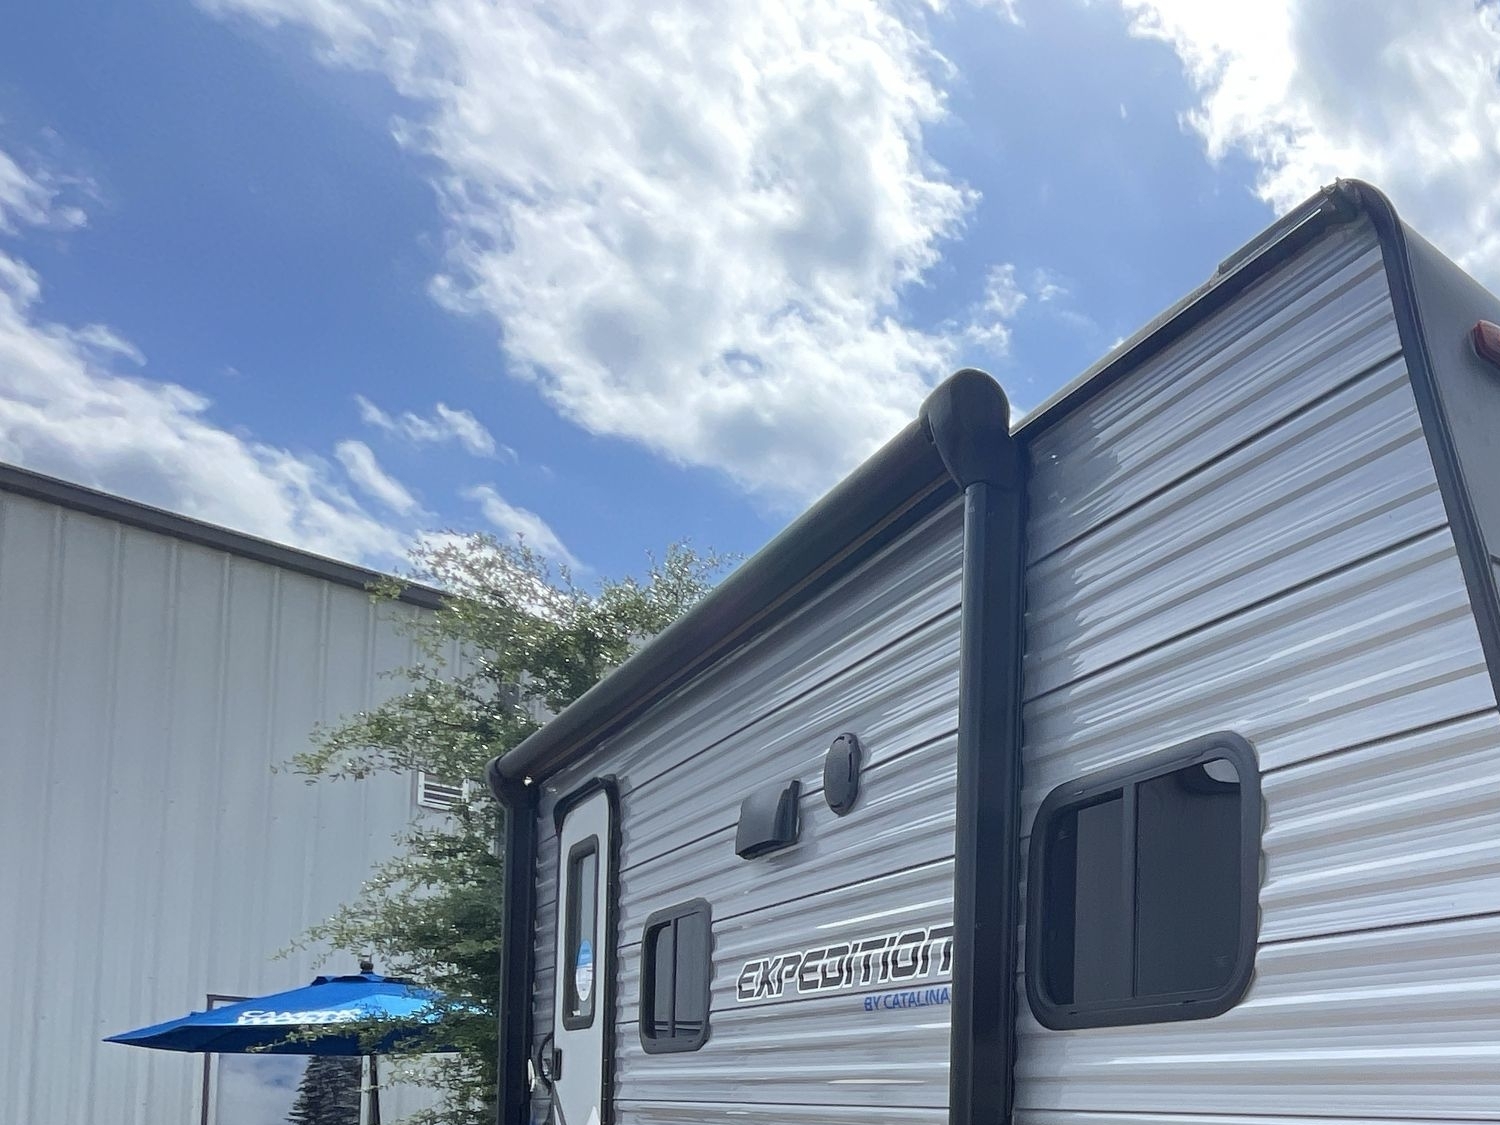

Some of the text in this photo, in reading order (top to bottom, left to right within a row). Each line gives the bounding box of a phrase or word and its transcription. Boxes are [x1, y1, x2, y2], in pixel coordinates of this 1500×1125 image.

[736, 922, 954, 1003] EXPEDITION
[863, 987, 951, 1012] BY CATALINA
